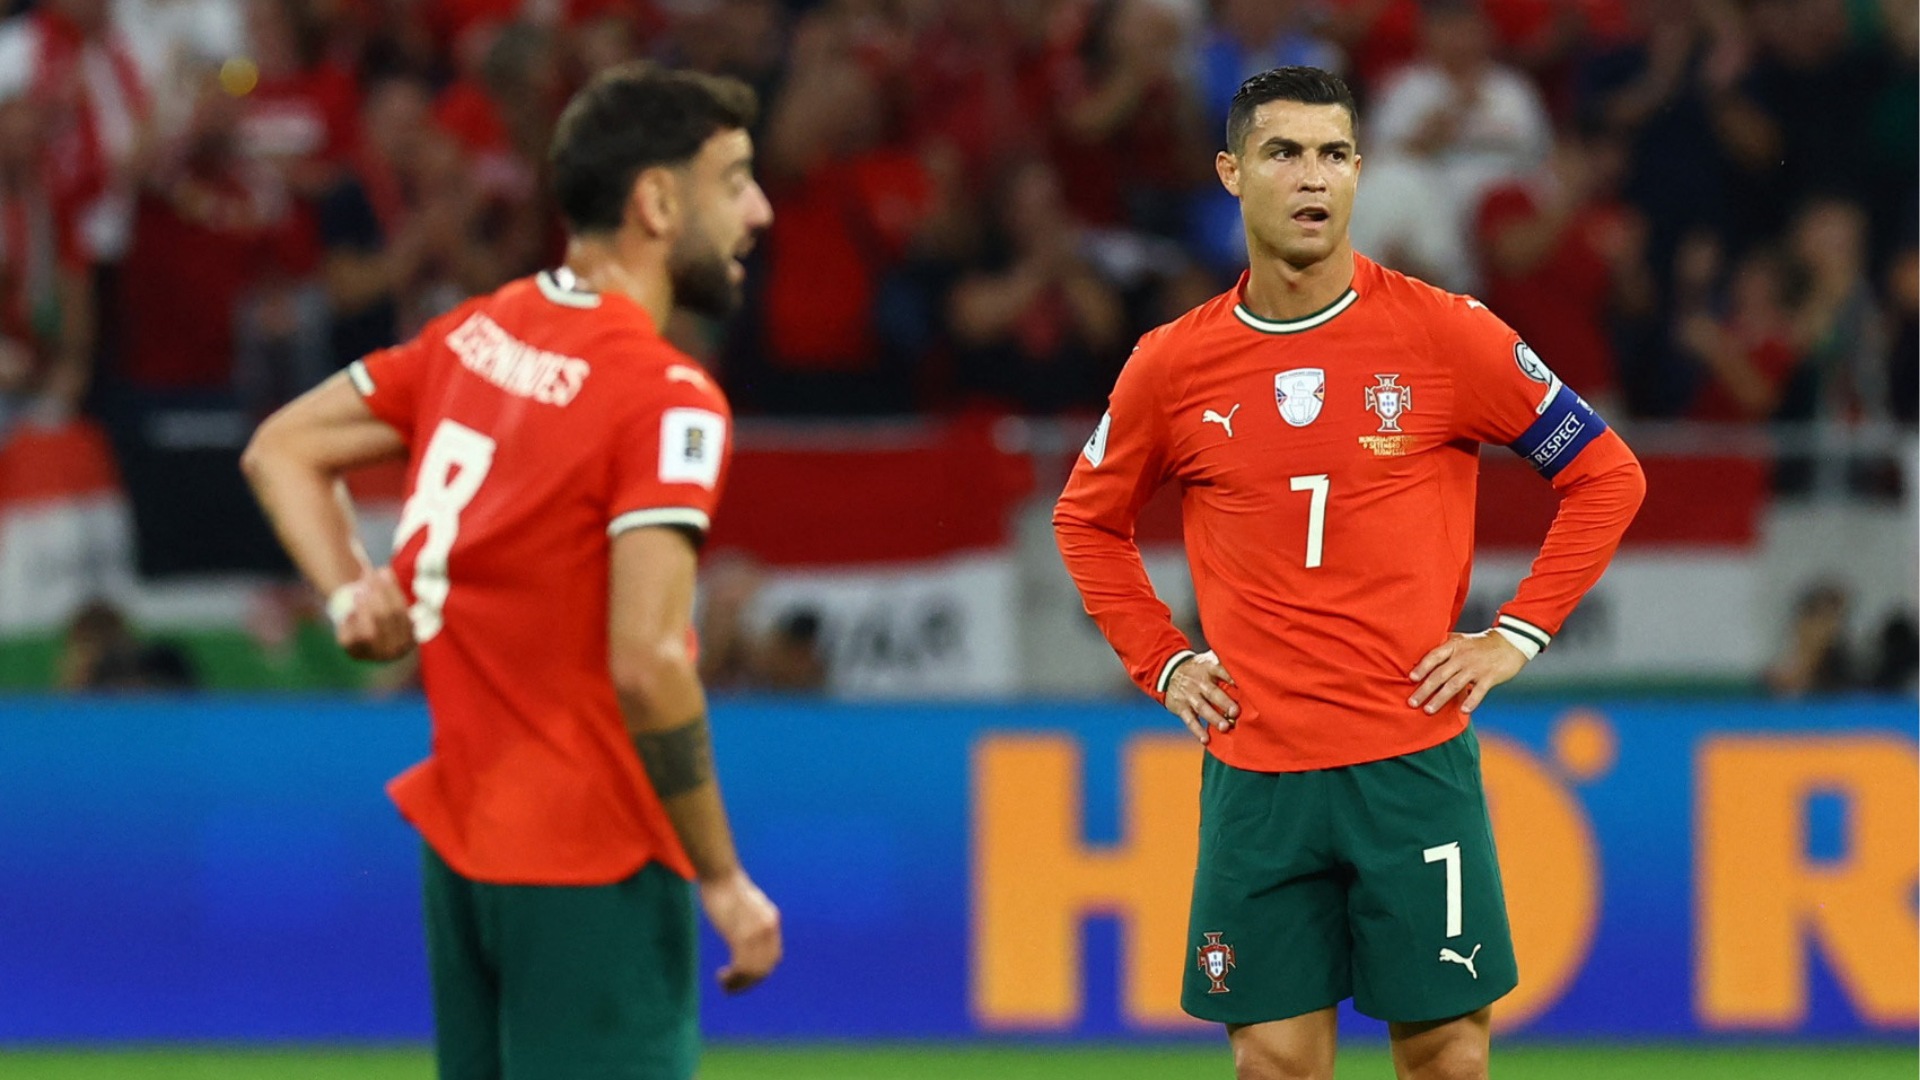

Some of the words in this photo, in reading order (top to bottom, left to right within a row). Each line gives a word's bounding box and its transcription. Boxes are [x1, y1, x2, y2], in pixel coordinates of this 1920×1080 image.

[1534, 414, 1582, 465] RESPECT
[392, 418, 497, 643] 8
[1289, 474, 1330, 568] 7
[1423, 842, 1462, 938] 7
